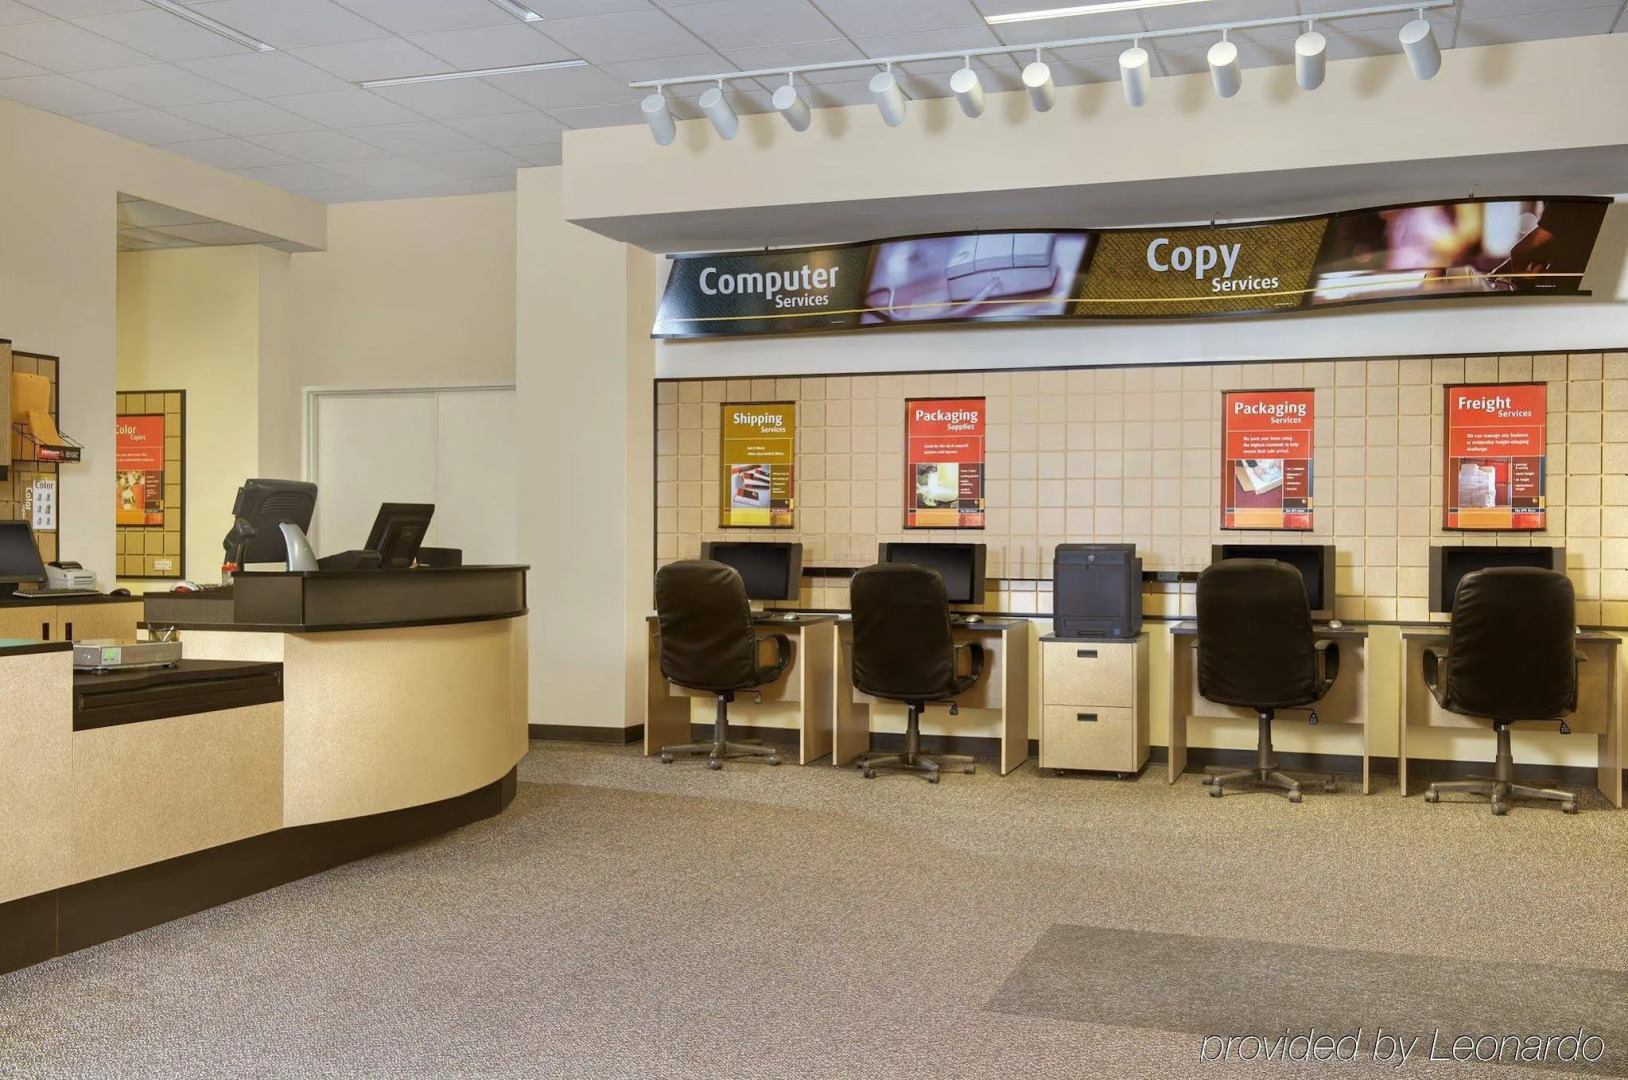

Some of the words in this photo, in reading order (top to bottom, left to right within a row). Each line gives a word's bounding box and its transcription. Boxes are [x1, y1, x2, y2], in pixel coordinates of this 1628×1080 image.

[1146, 238, 1242, 280] Copy
[699, 264, 840, 300] Computer
[1211, 275, 1279, 292] Services
[775, 293, 829, 309] Services
[1234, 401, 1307, 417] Packaging
[1458, 396, 1512, 413] Freight
[733, 412, 783, 427] Shipping
[915, 408, 979, 424] Packaging
[1270, 416, 1302, 424] Services
[1497, 409, 1532, 418] Services
[115, 424, 137, 436] Color
[760, 426, 786, 434] Services
[947, 423, 975, 432] Supplies
[35, 480, 54, 490] Color
[25, 487, 33, 511] Color
